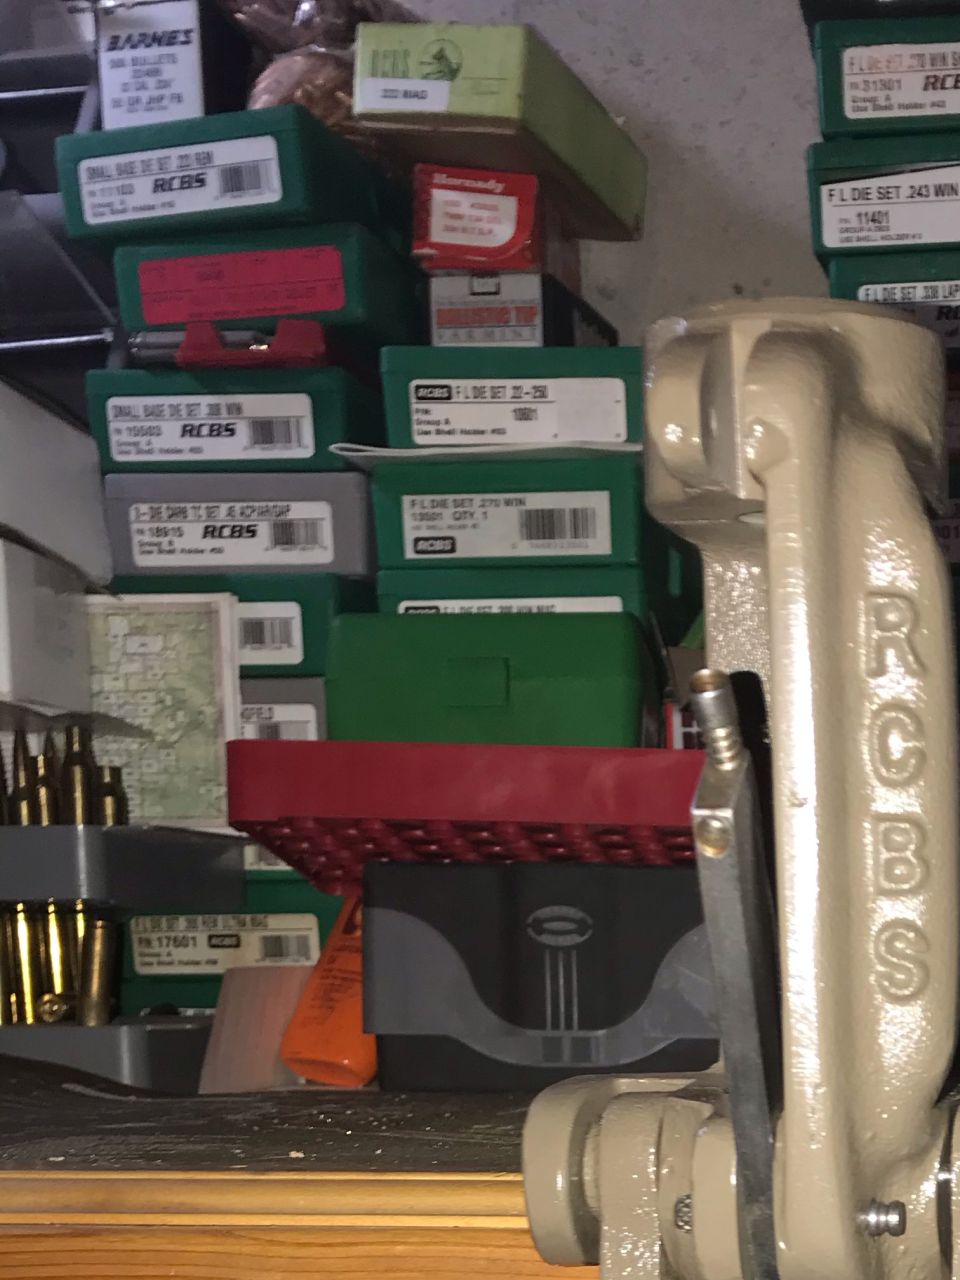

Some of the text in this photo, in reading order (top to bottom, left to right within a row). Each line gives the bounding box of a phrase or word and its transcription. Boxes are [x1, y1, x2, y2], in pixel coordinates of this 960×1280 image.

[106, 29, 194, 52] BARNES
[153, 172, 206, 193] RCBS
[430, 171, 505, 193] Hornady
[828, 182, 959, 202] F L DIE SET .243 WIN
[856, 210, 890, 225] 11401
[180, 423, 236, 438] RCBS
[504, 496, 527, 507] WIN
[202, 523, 259, 539] RCBS
[863, 590, 931, 1002] RCBS
